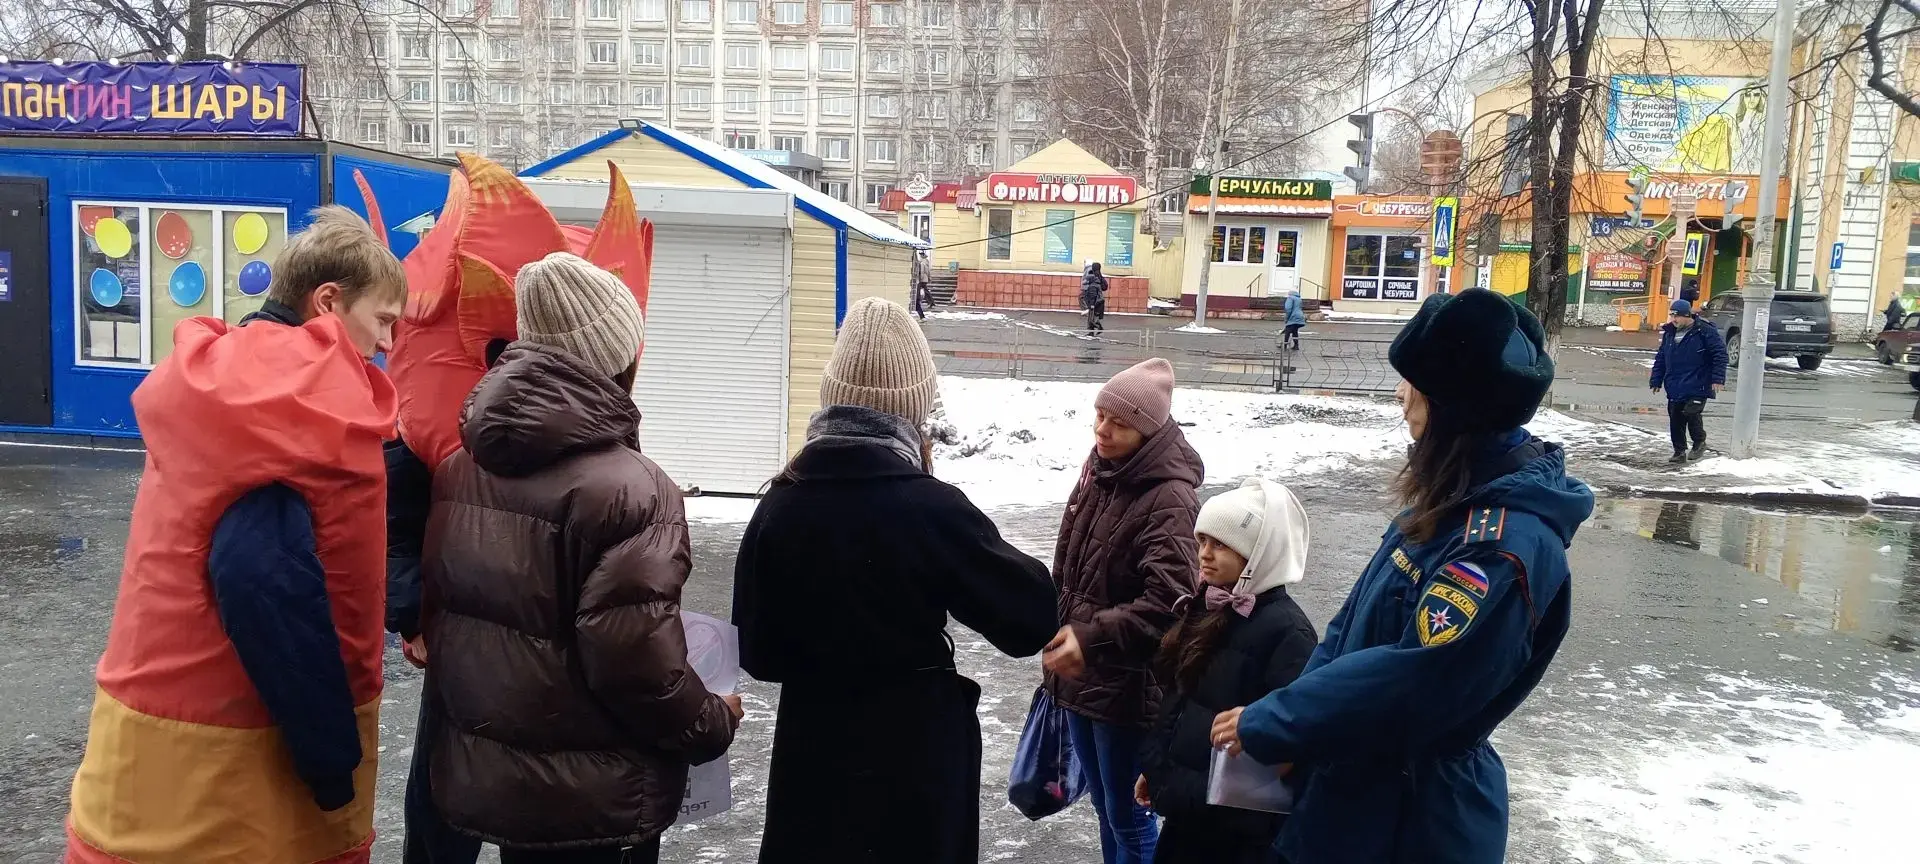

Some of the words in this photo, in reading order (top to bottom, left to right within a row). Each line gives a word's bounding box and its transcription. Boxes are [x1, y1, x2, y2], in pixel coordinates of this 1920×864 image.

[151, 84, 286, 121] ШАРЫ
[1631, 111, 1677, 120] Мужская
[1630, 120, 1671, 128] Детская
[1629, 131, 1674, 140] Одежда
[1628, 144, 1662, 153] Обувь
[1036, 174, 1088, 184] АПТЕКА
[1209, 178, 1262, 193] ЕРЧУ
[1344, 280, 1376, 289] КАРТОШКА
[1387, 281, 1412, 290] СОЧНЫЕ
[1353, 288, 1367, 297] ФРИ
[1384, 289, 1415, 298] ЧЕБУРЕКИ
[1452, 575, 1478, 590] РОССИЯ
[1432, 586, 1450, 597] МЧС
[1449, 592, 1476, 616] РОССИИ
